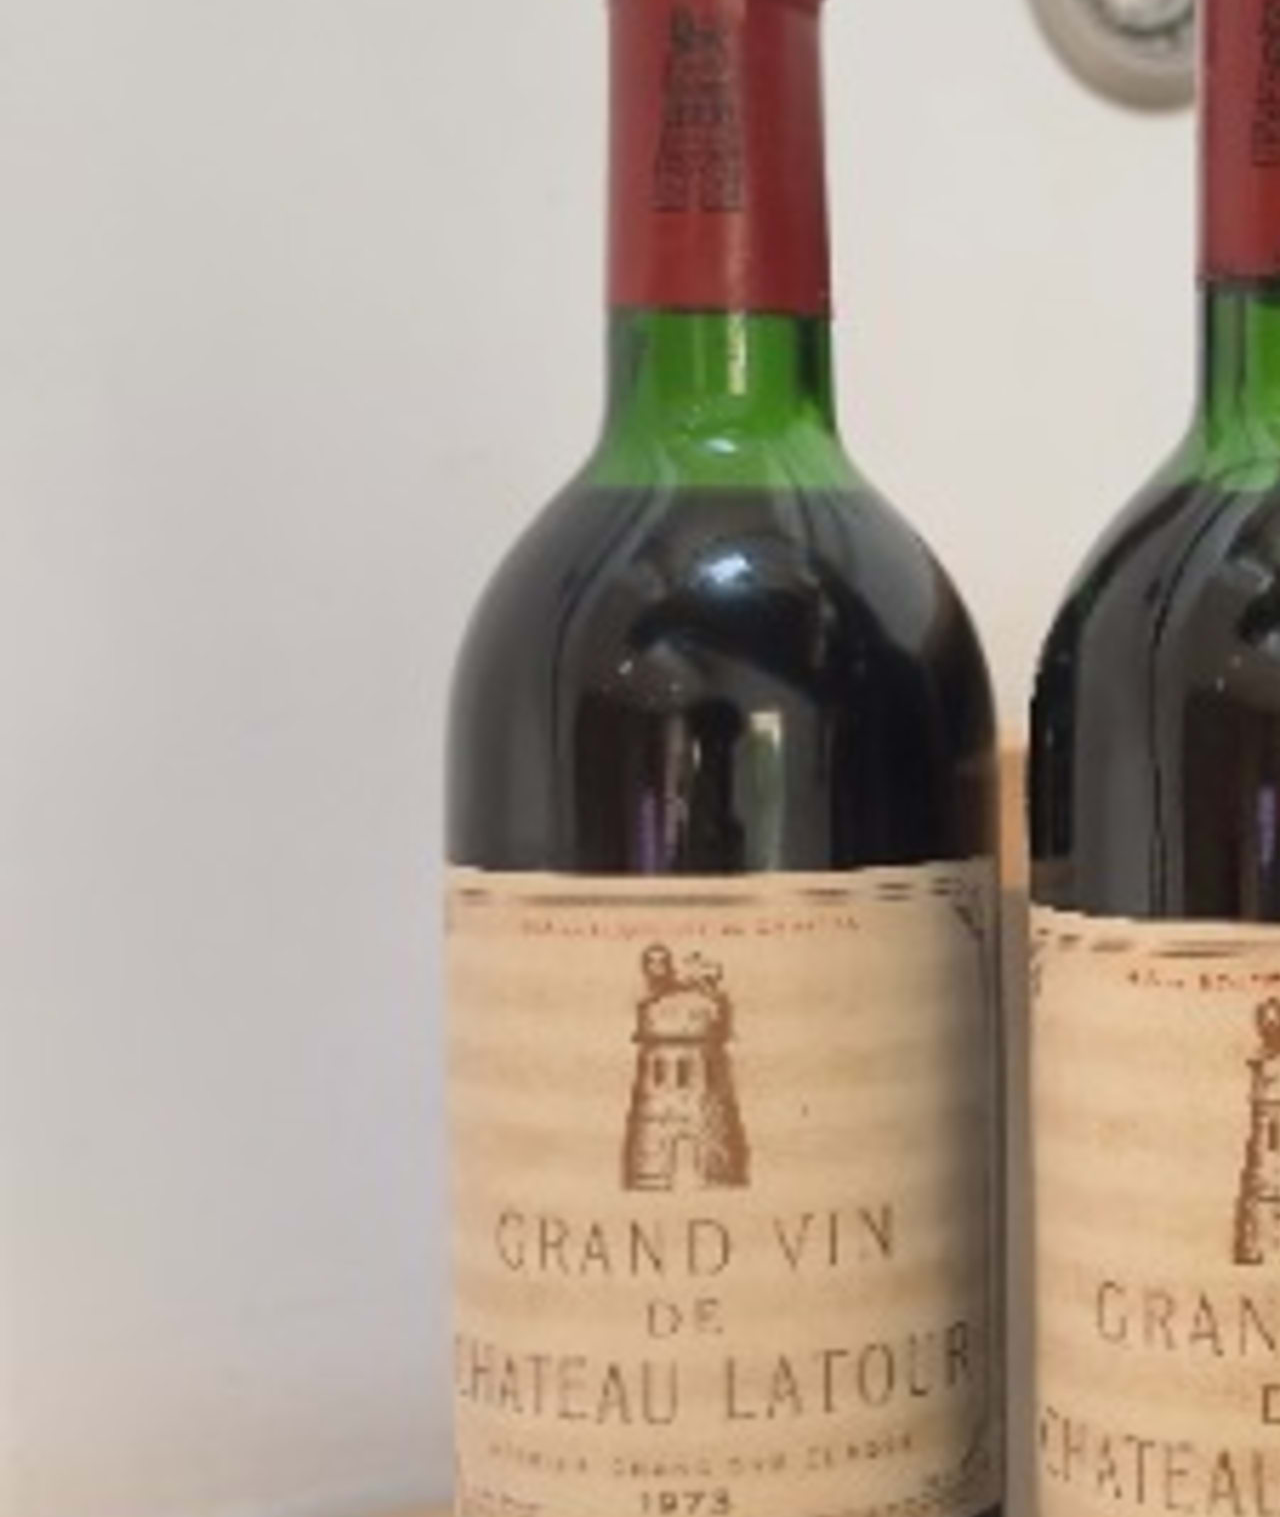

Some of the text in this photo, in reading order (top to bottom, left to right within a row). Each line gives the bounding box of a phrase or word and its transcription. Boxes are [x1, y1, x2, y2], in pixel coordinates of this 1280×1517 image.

[495, 1204, 893, 1278] GRAND VIN
[646, 1297, 724, 1338] DE
[641, 1489, 732, 1517] 1973
